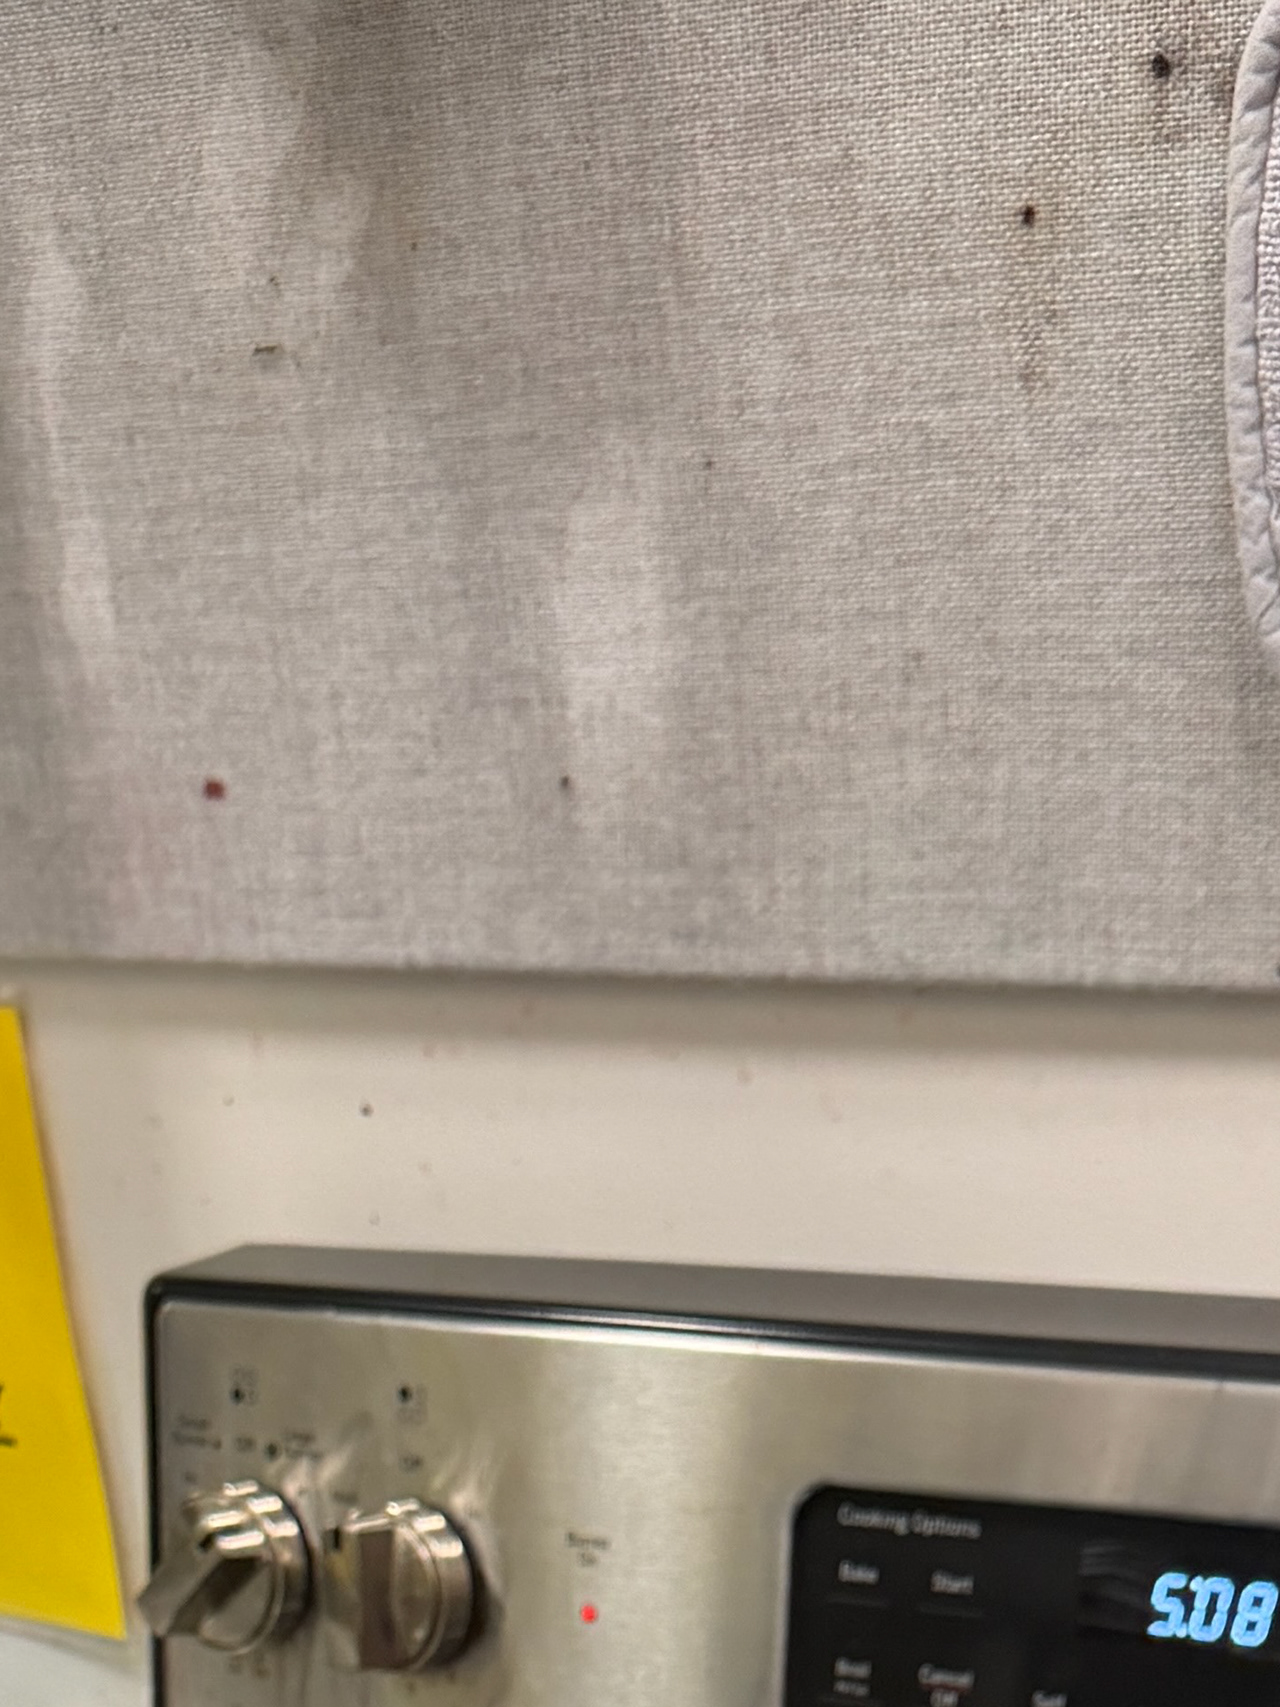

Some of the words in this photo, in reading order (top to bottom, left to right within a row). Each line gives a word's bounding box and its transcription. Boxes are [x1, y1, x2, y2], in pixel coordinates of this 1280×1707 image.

[837, 1502, 910, 1536] Cooking
[912, 1508, 983, 1539] Options
[930, 1570, 974, 1596] Start
[918, 1662, 975, 1686] Cancel
